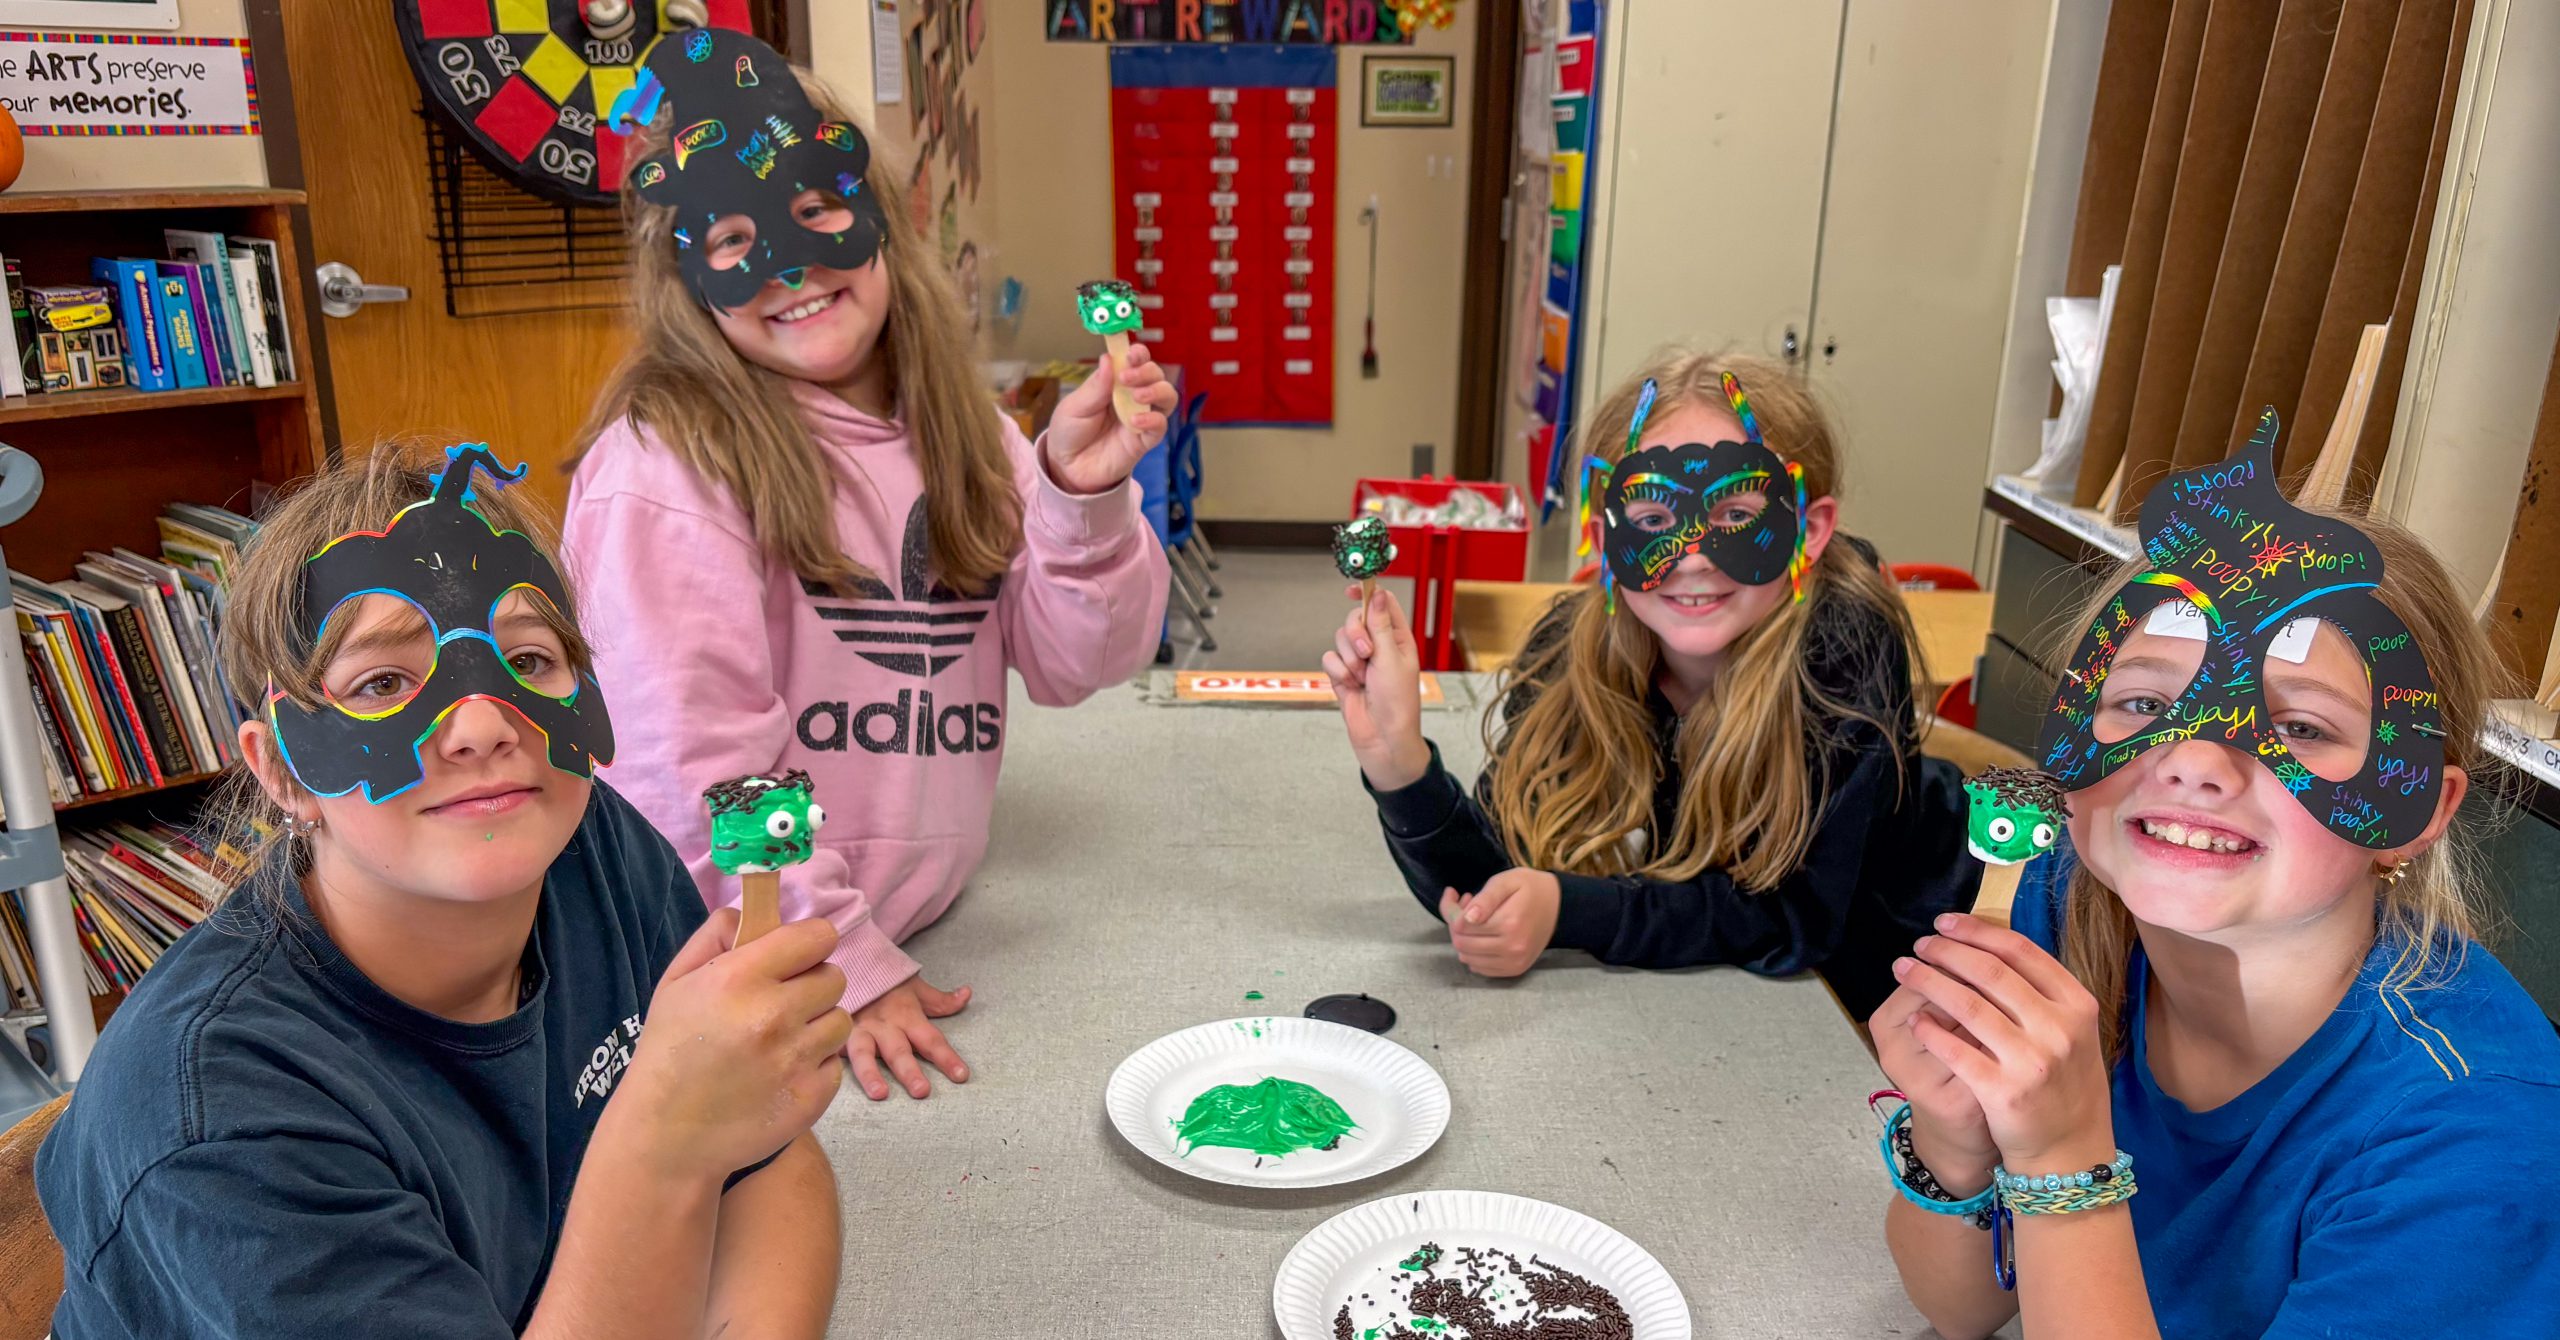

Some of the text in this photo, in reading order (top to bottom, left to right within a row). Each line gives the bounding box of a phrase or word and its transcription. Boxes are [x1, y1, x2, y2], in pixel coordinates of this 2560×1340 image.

[26, 49, 103, 85] ARTS
[107, 58, 206, 85] preserve
[484, 34, 521, 77] 75
[585, 39, 633, 64] 100
[438, 41, 491, 106] 50
[49, 87, 192, 119] memories.
[557, 105, 596, 137] 75
[539, 138, 596, 186] 50
[575, 1028, 620, 1110] IRON
